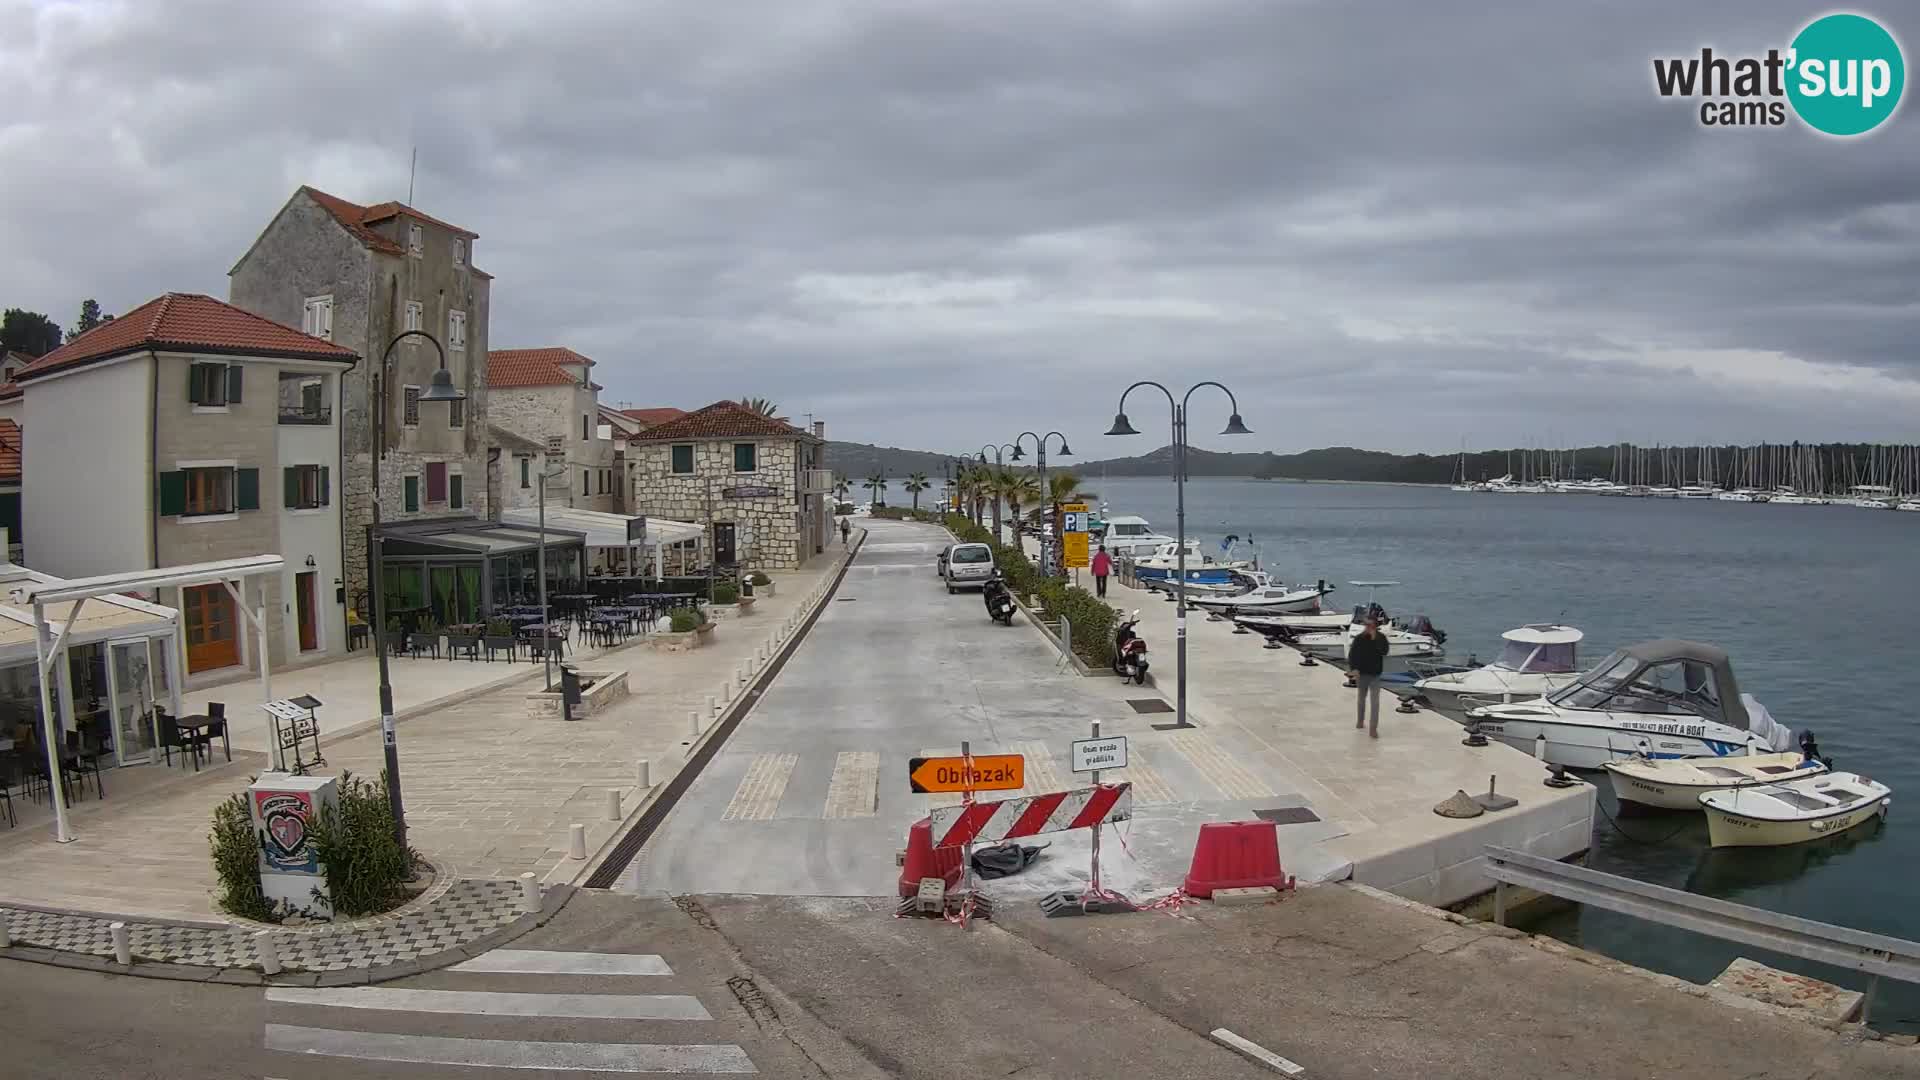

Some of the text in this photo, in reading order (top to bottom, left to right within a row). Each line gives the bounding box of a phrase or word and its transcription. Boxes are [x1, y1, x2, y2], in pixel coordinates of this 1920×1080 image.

[1065, 514, 1076, 530] P
[1659, 724, 1679, 733] RENT
[1679, 725, 1685, 734] A
[1686, 725, 1706, 737] BOAT
[936, 763, 1016, 784] Obilazak
